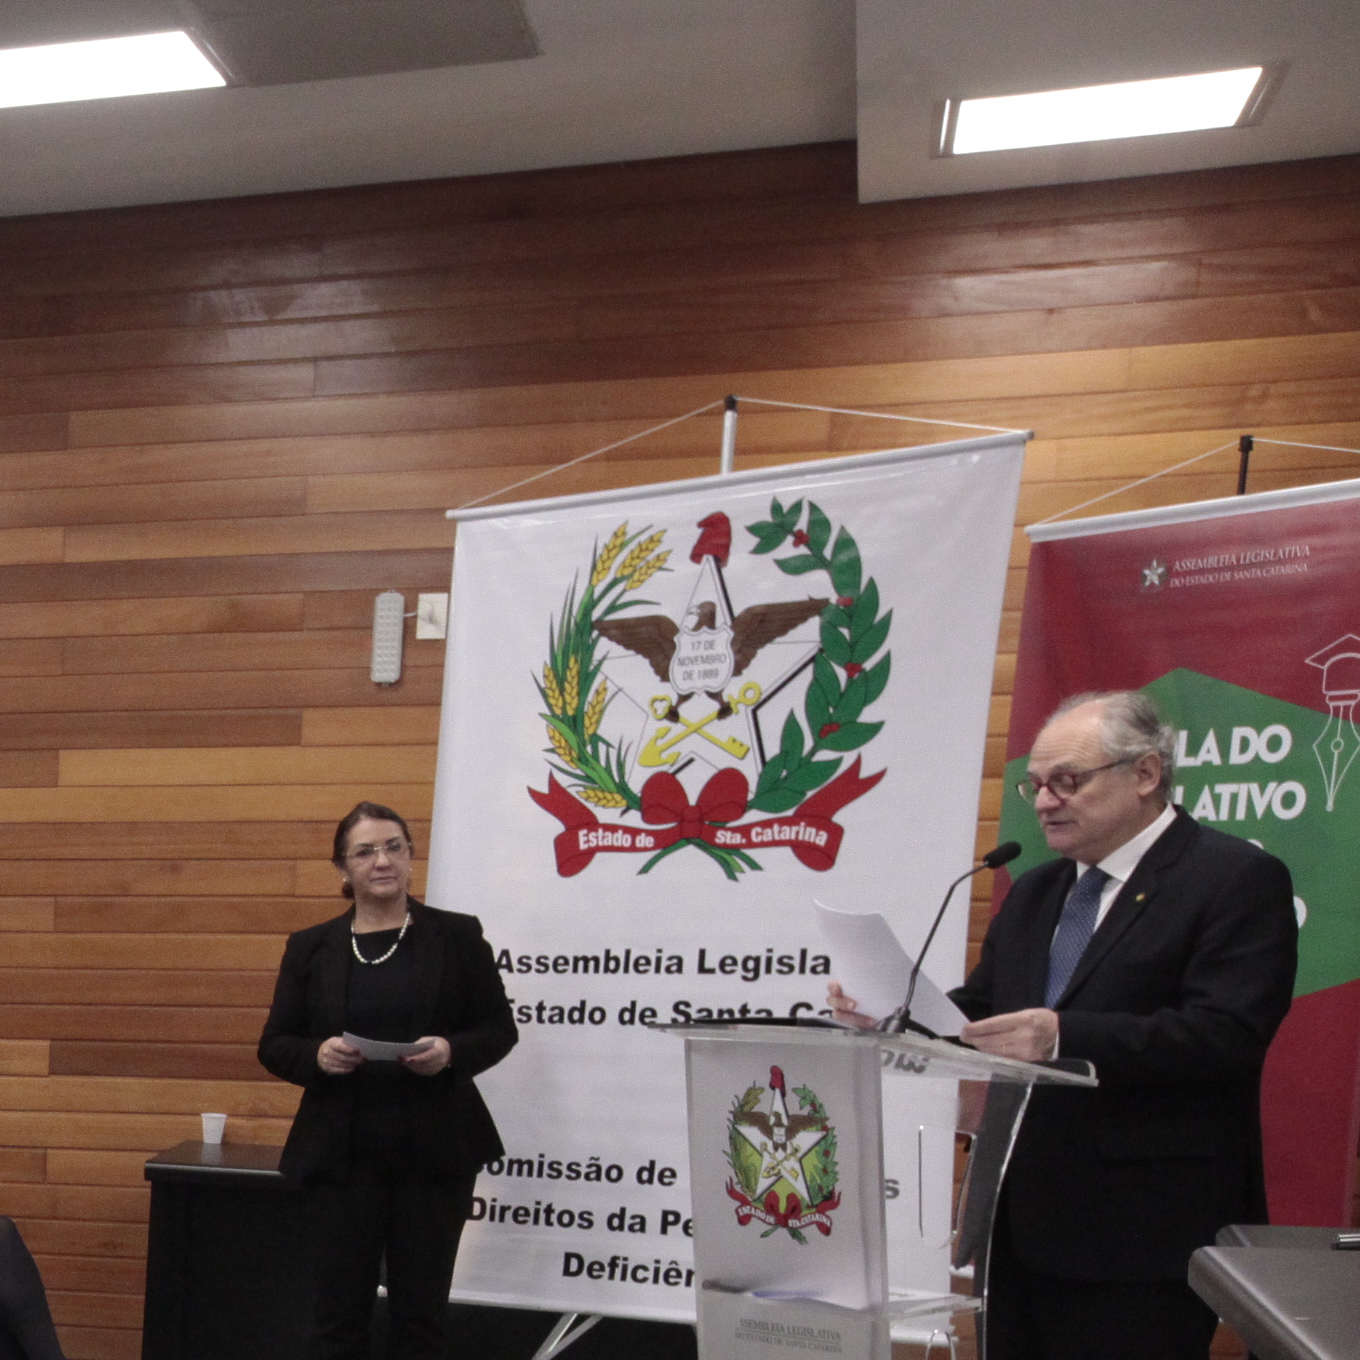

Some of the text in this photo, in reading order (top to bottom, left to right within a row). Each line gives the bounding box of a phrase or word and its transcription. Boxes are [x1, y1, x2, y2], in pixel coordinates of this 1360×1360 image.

[1173, 545, 1311, 573] ASSEMBLEIA LEGISLATIVA
[1186, 573, 1218, 586] ESTADO
[1220, 570, 1231, 581] DE
[1234, 568, 1261, 580] SANTA
[1263, 563, 1308, 579] CATARINA
[1229, 724, 1292, 765] DO
[579, 829, 654, 850] Estado de
[715, 822, 828, 846] Sta. Catarina
[495, 949, 831, 982] Assembleia Legisla
[618, 1000, 657, 1026] de
[482, 1153, 623, 1183] omissão
[636, 1160, 677, 1186] de
[467, 1196, 594, 1230] Direitos
[606, 1207, 646, 1233] da
